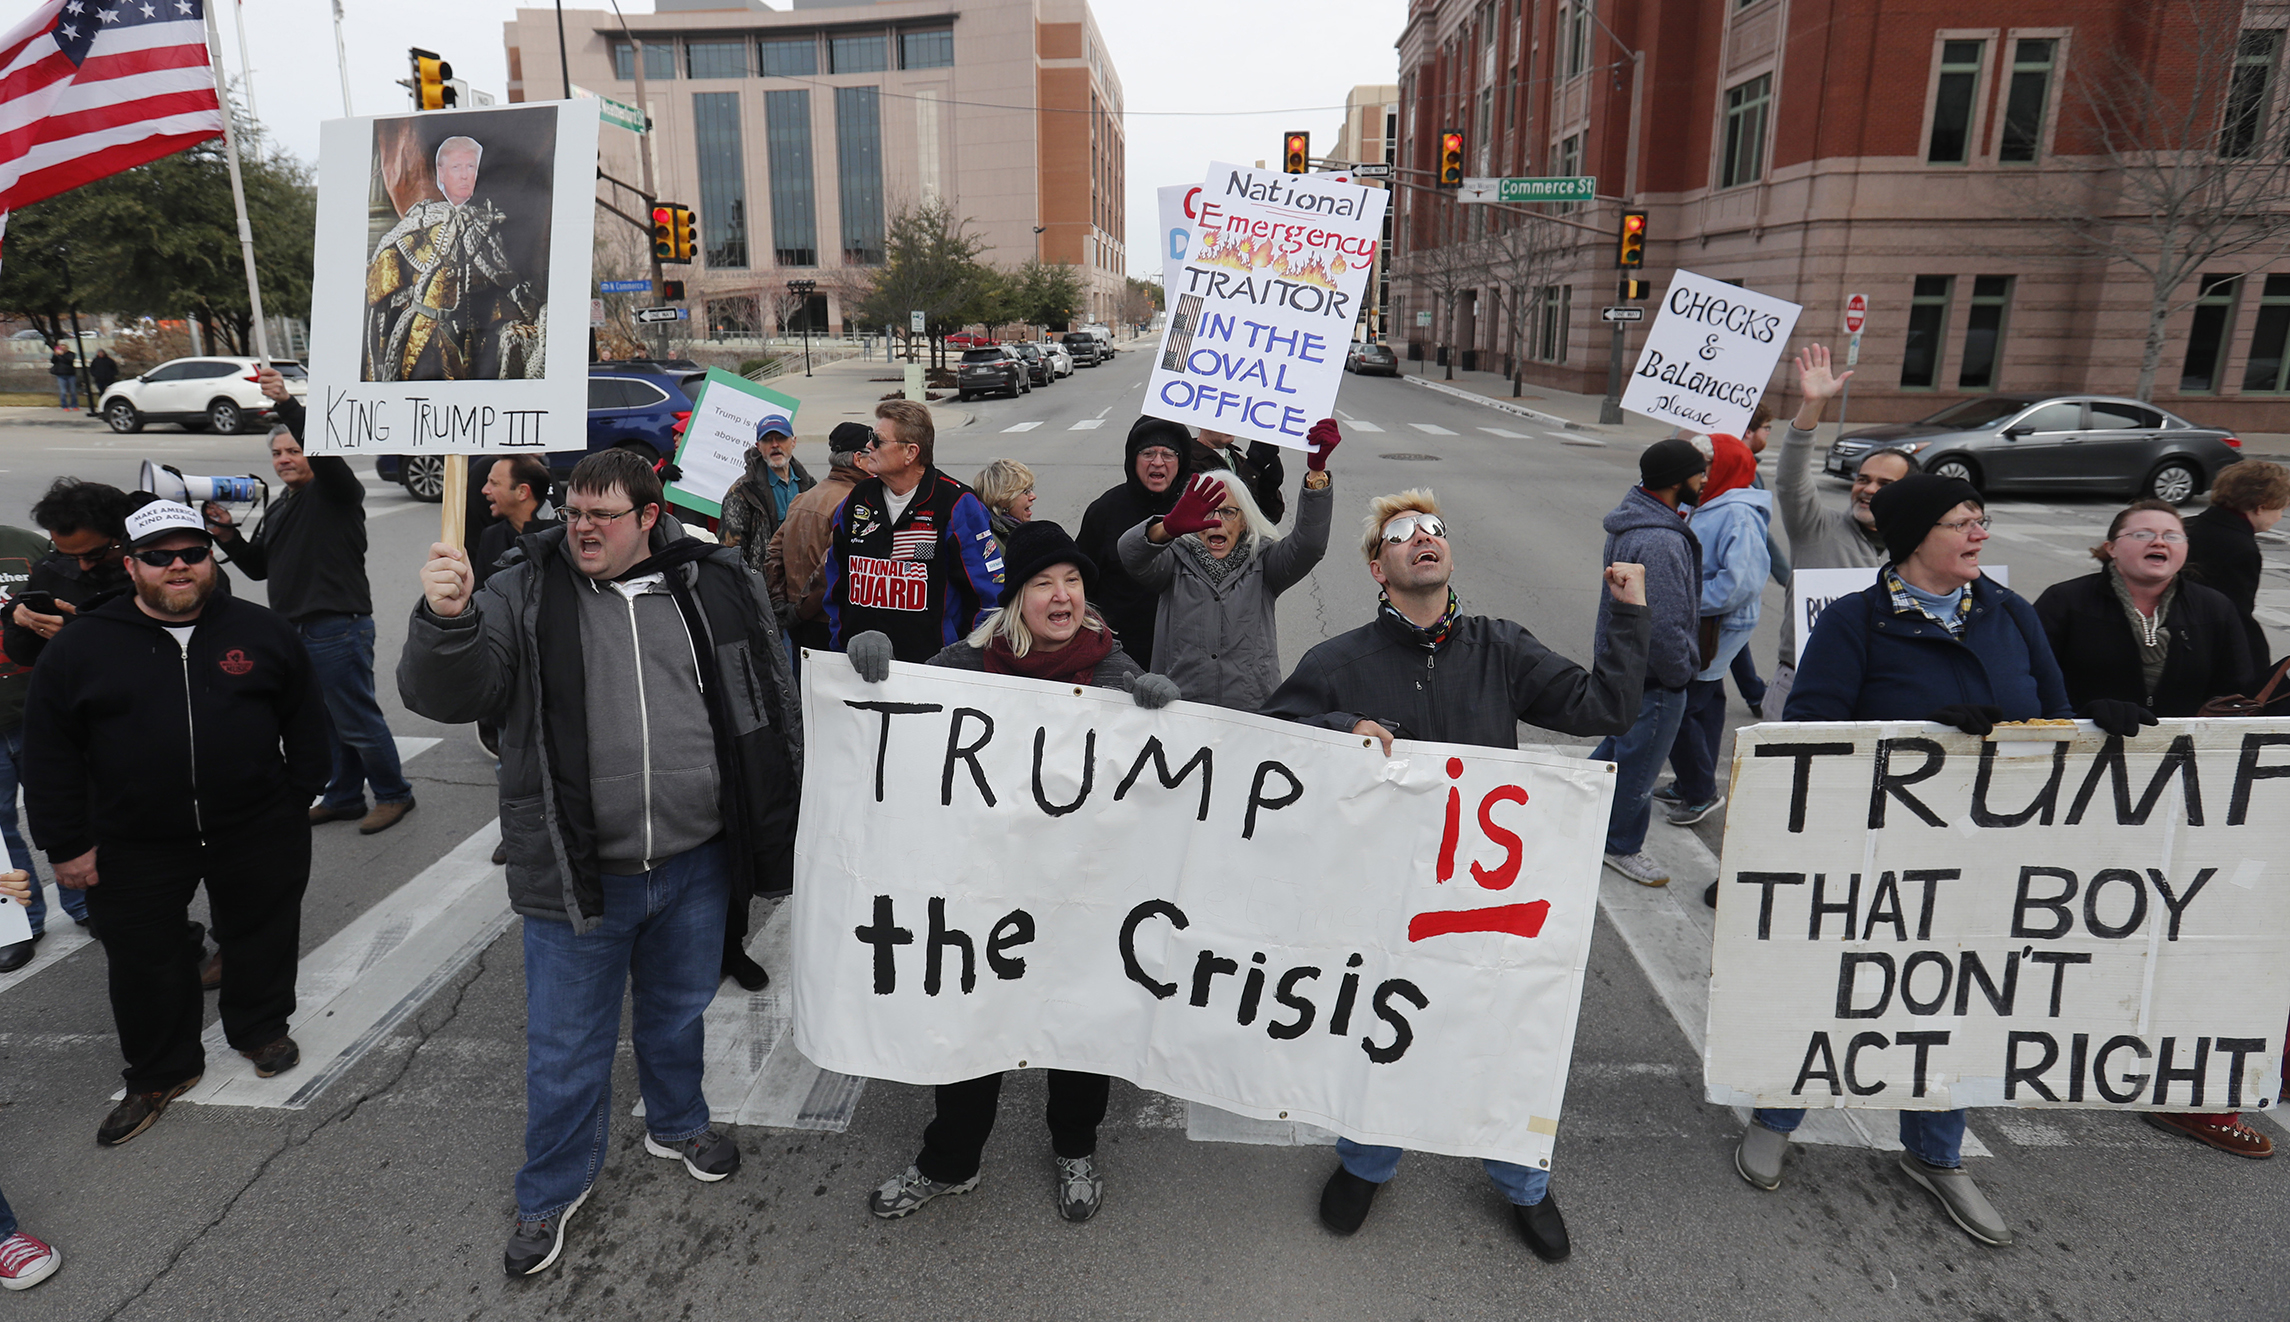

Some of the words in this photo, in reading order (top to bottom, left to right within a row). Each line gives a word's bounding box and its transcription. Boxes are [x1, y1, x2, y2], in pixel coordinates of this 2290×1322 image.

[1361, 166, 1373, 174] ONE
[1500, 179, 1575, 195] Commerce
[1577, 178, 1593, 194] St
[1225, 169, 1369, 221] National
[1197, 201, 1378, 270] Emergency
[615, 282, 644, 290] Commerce
[1184, 266, 1350, 320] TRAITOR
[1197, 310, 1236, 342] IN
[1243, 320, 1327, 364] THE
[1698, 333, 1725, 360] &
[1186, 348, 1297, 394] OVAL
[325, 385, 390, 449] KING
[405, 397, 495, 448] TRUMP
[498, 410, 549, 447] III
[715, 406, 742, 424] Trump
[743, 418, 751, 427] is
[1160, 379, 1307, 437] OFFICE
[713, 451, 729, 462] law
[714, 430, 741, 445] above
[134, 509, 158, 522] MAKE
[160, 507, 197, 518] AMERICA
[139, 515, 163, 528] KIND
[166, 514, 197, 524] AGAIN
[849, 555, 905, 578] NATIONAL
[849, 572, 928, 611] GUARD
[843, 699, 1304, 841] TRUMP
[1435, 757, 1530, 891] is
[1736, 867, 1962, 942] THAT
[2010, 865, 2219, 942] BOY
[855, 893, 1037, 997] the
[1118, 898, 1431, 1065] Crisis
[1835, 944, 2092, 1020] DON'T
[1791, 1030, 1951, 1098] ACT
[2004, 1030, 2271, 1109] RIGHT.
